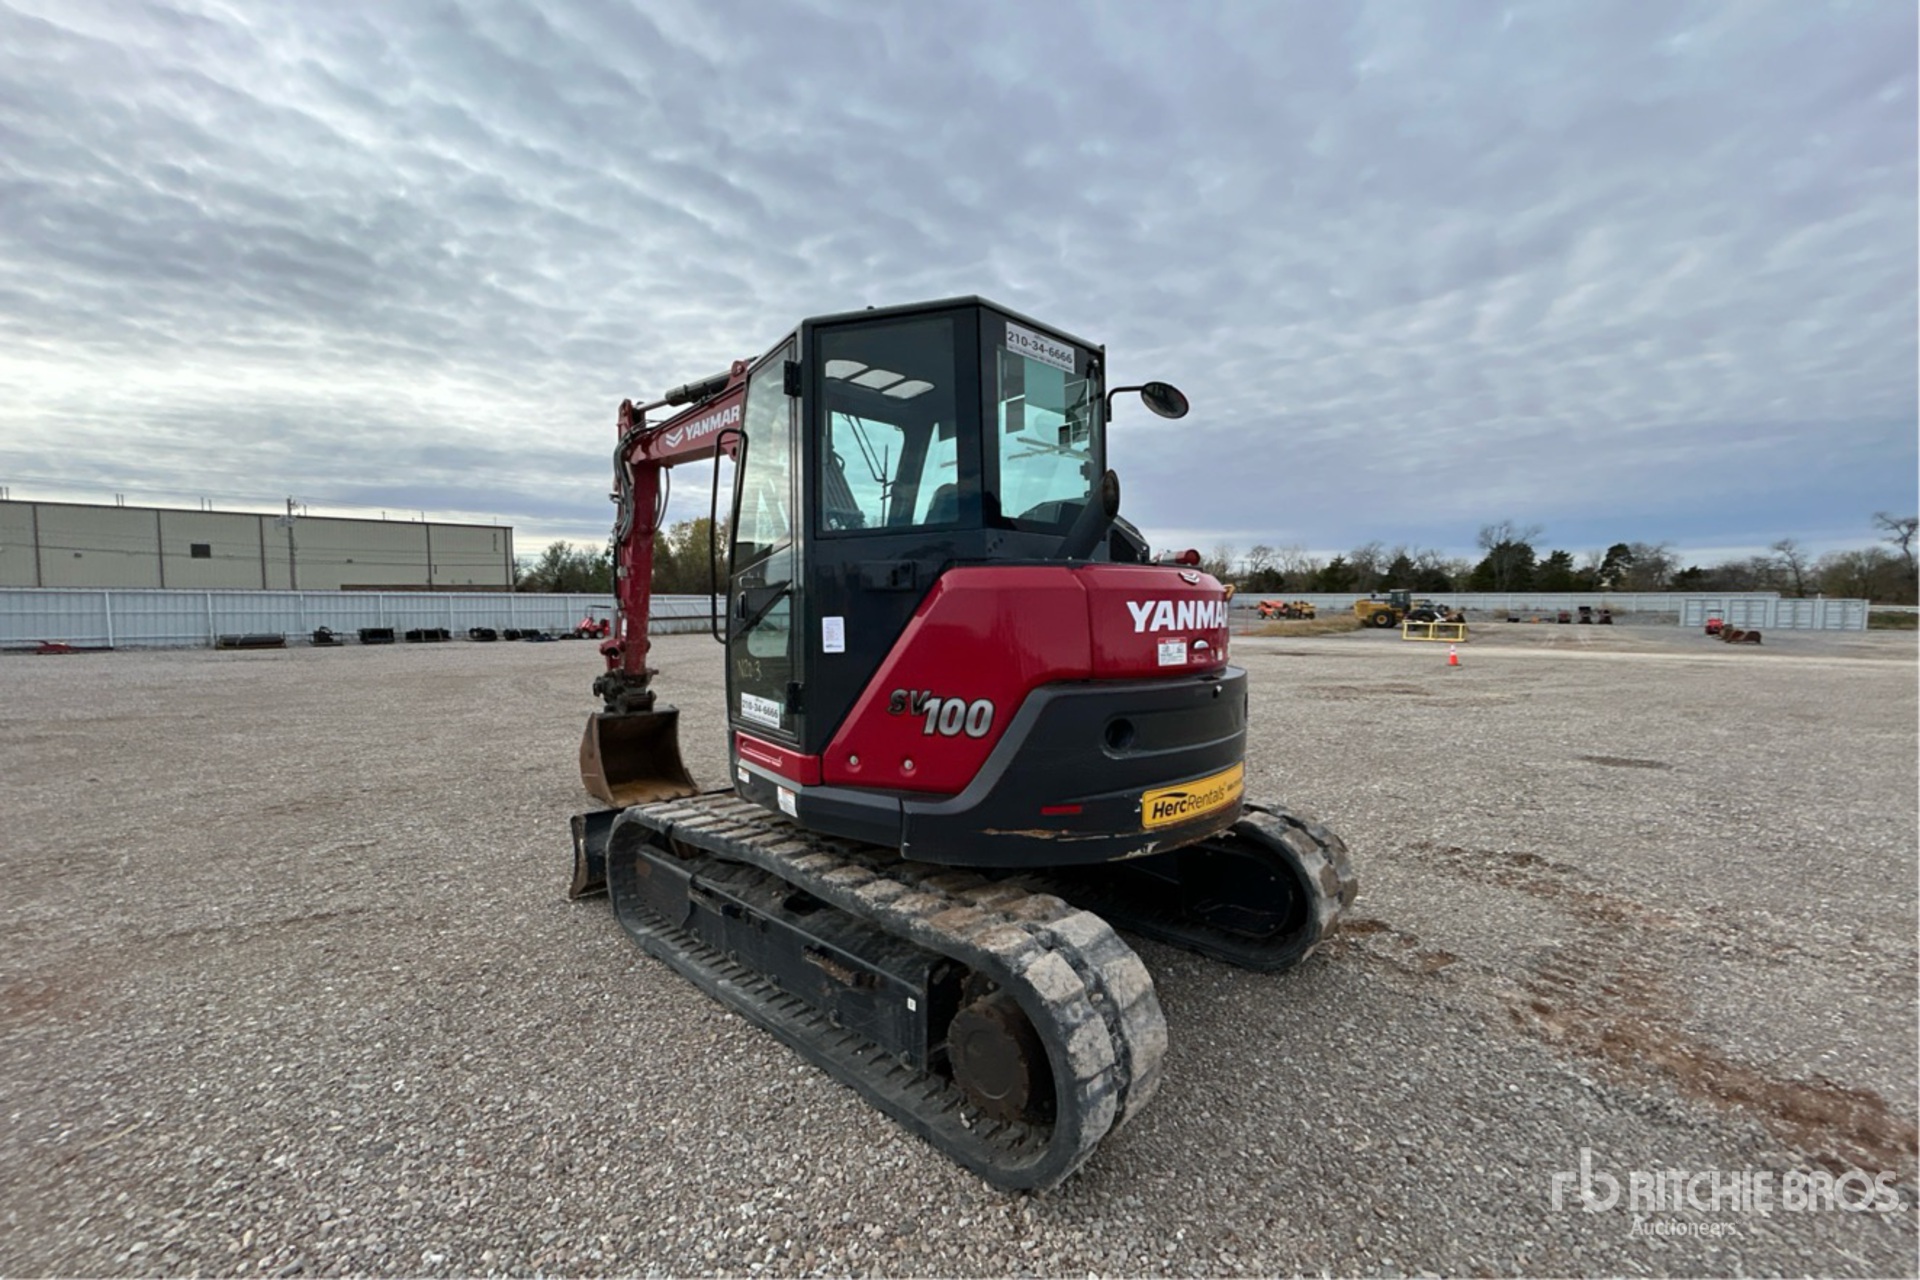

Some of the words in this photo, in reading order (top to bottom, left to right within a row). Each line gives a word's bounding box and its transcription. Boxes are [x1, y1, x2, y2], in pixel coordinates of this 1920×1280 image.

[1007, 331, 1073, 364] 210-34-6666
[685, 405, 741, 441] YANMAR
[1126, 600, 1228, 633] YANMA
